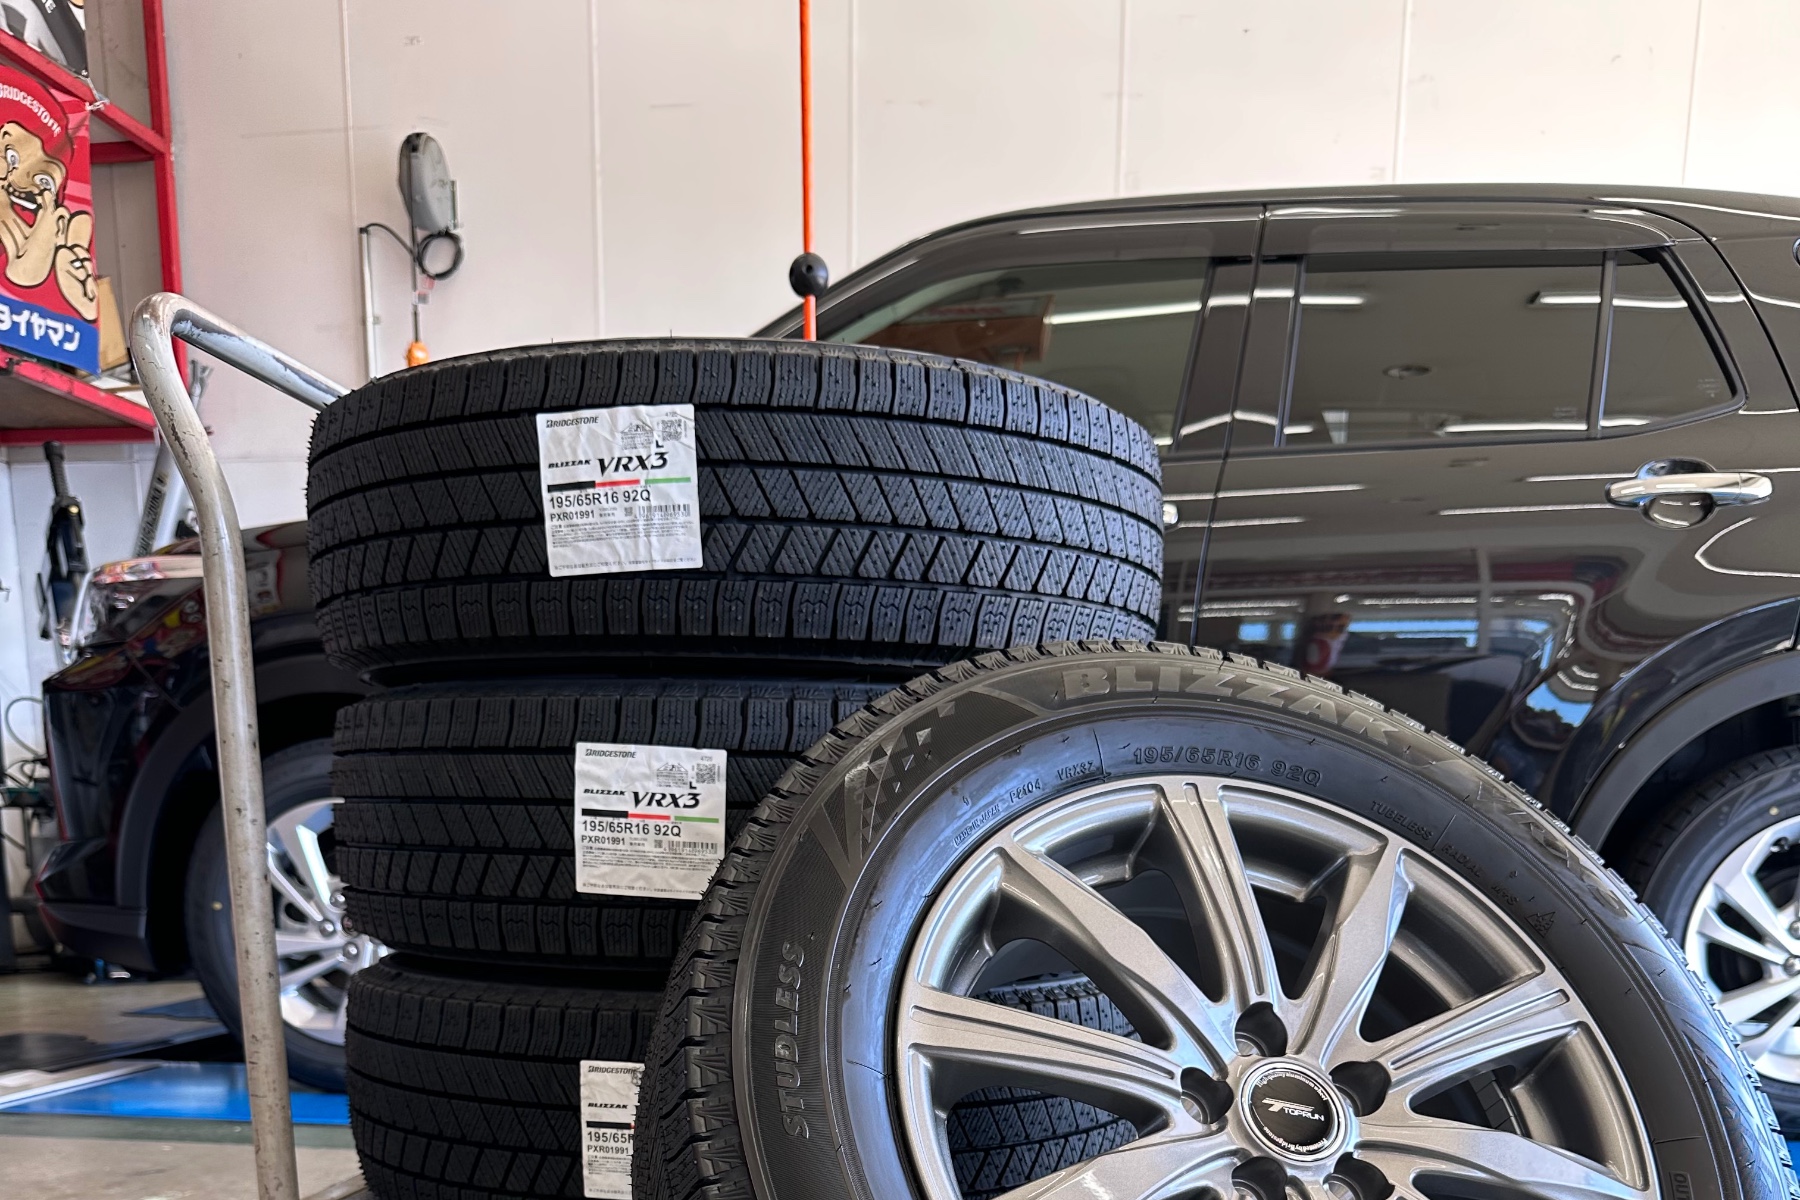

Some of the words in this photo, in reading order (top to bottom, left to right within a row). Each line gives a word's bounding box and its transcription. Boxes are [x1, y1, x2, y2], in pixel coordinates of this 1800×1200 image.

[546, 416, 599, 428] BRIDGESTONE
[548, 459, 591, 469] BLIZZAK
[597, 452, 669, 477] VRX3
[550, 491, 619, 509] 195/65R16
[623, 489, 651, 503] 92Q
[550, 510, 595, 522] PXR01991
[1062, 665, 1401, 746] BLIZZAK
[585, 748, 637, 759] BRIDGESTONE
[1133, 746, 1261, 771] 195/65R16
[1271, 760, 1322, 788] 92Q
[583, 788, 627, 797] BLIZZAK
[631, 791, 701, 809] VRX3
[582, 820, 649, 836] 195/65R16
[654, 823, 681, 838] 92Q
[581, 834, 626, 846] PXR01991
[1370, 800, 1434, 841] TUBELESS
[1441, 843, 1481, 878] RADIAL
[773, 941, 809, 1139] STUDLESS
[587, 1102, 629, 1110] BLIZZAK
[1283, 1106, 1325, 1122] TOPRUN
[587, 1144, 629, 1155] PXR01991
